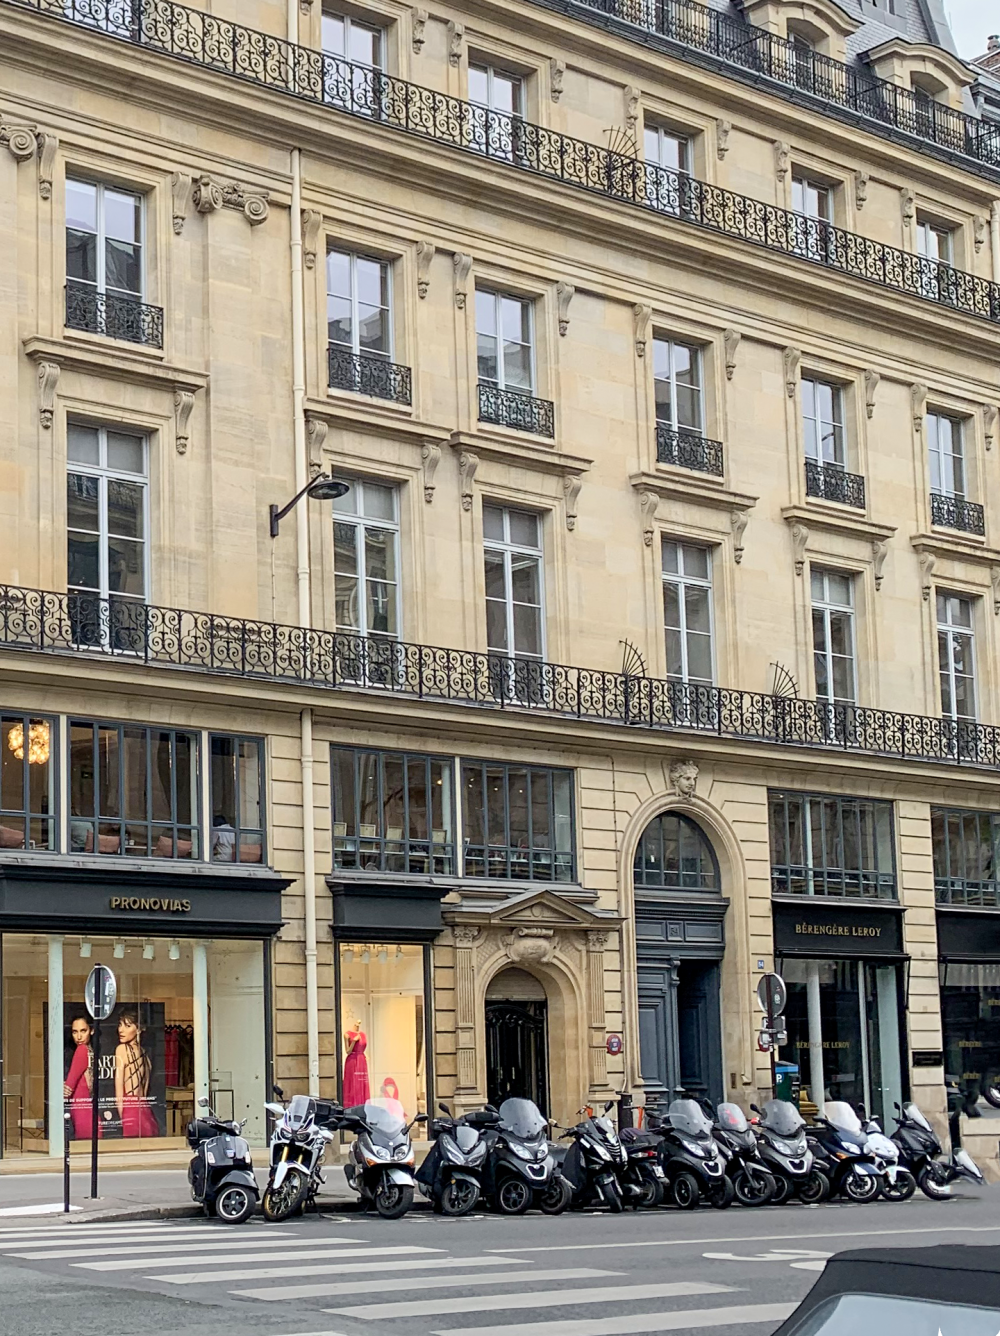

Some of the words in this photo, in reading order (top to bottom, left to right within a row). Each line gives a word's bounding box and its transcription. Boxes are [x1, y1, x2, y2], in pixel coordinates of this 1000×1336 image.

[110, 896, 191, 912] PRONOVIAS
[795, 922, 850, 936] BÉRENGÈRE
[852, 926, 882, 937] LEROY
